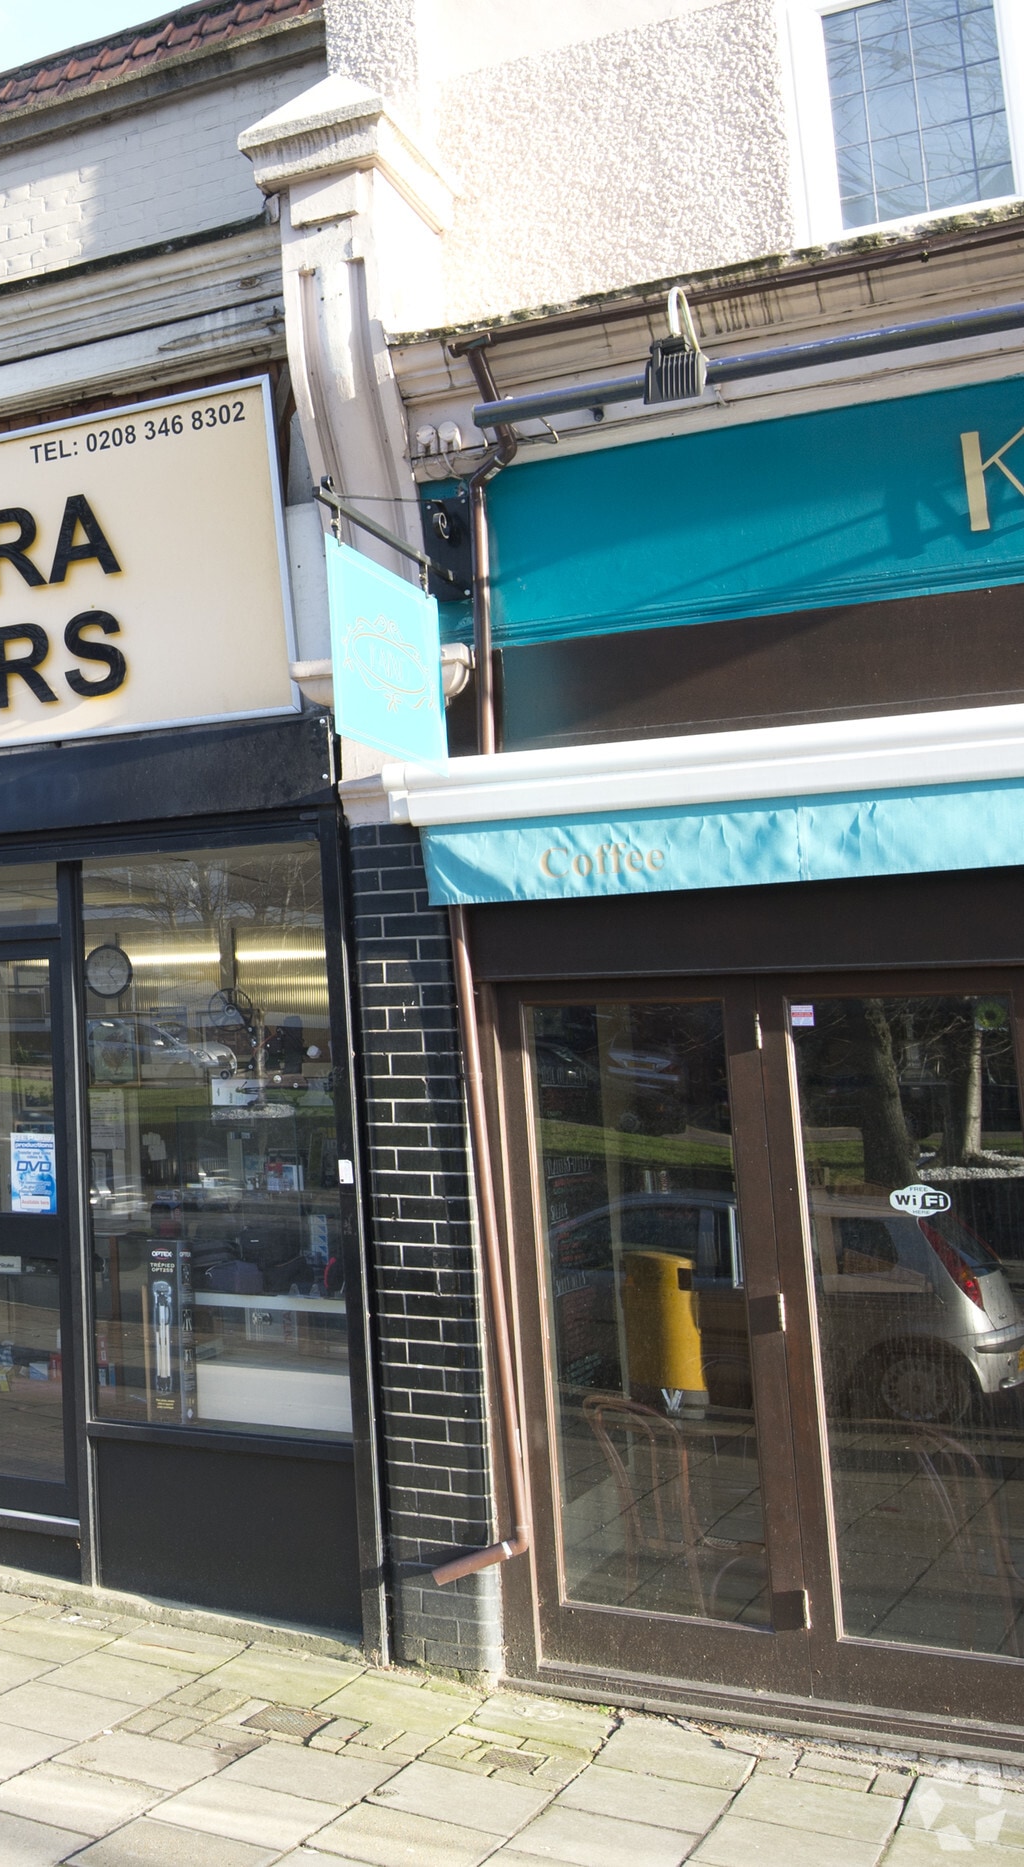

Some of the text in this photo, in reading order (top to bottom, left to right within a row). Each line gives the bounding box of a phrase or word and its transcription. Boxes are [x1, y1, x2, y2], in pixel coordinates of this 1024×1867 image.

[29, 401, 246, 464] TEL: 0208 346 8302
[539, 842, 665, 879] Coffee
[16, 1160, 52, 1172] DVD
[151, 1250, 174, 1258] OPTEX
